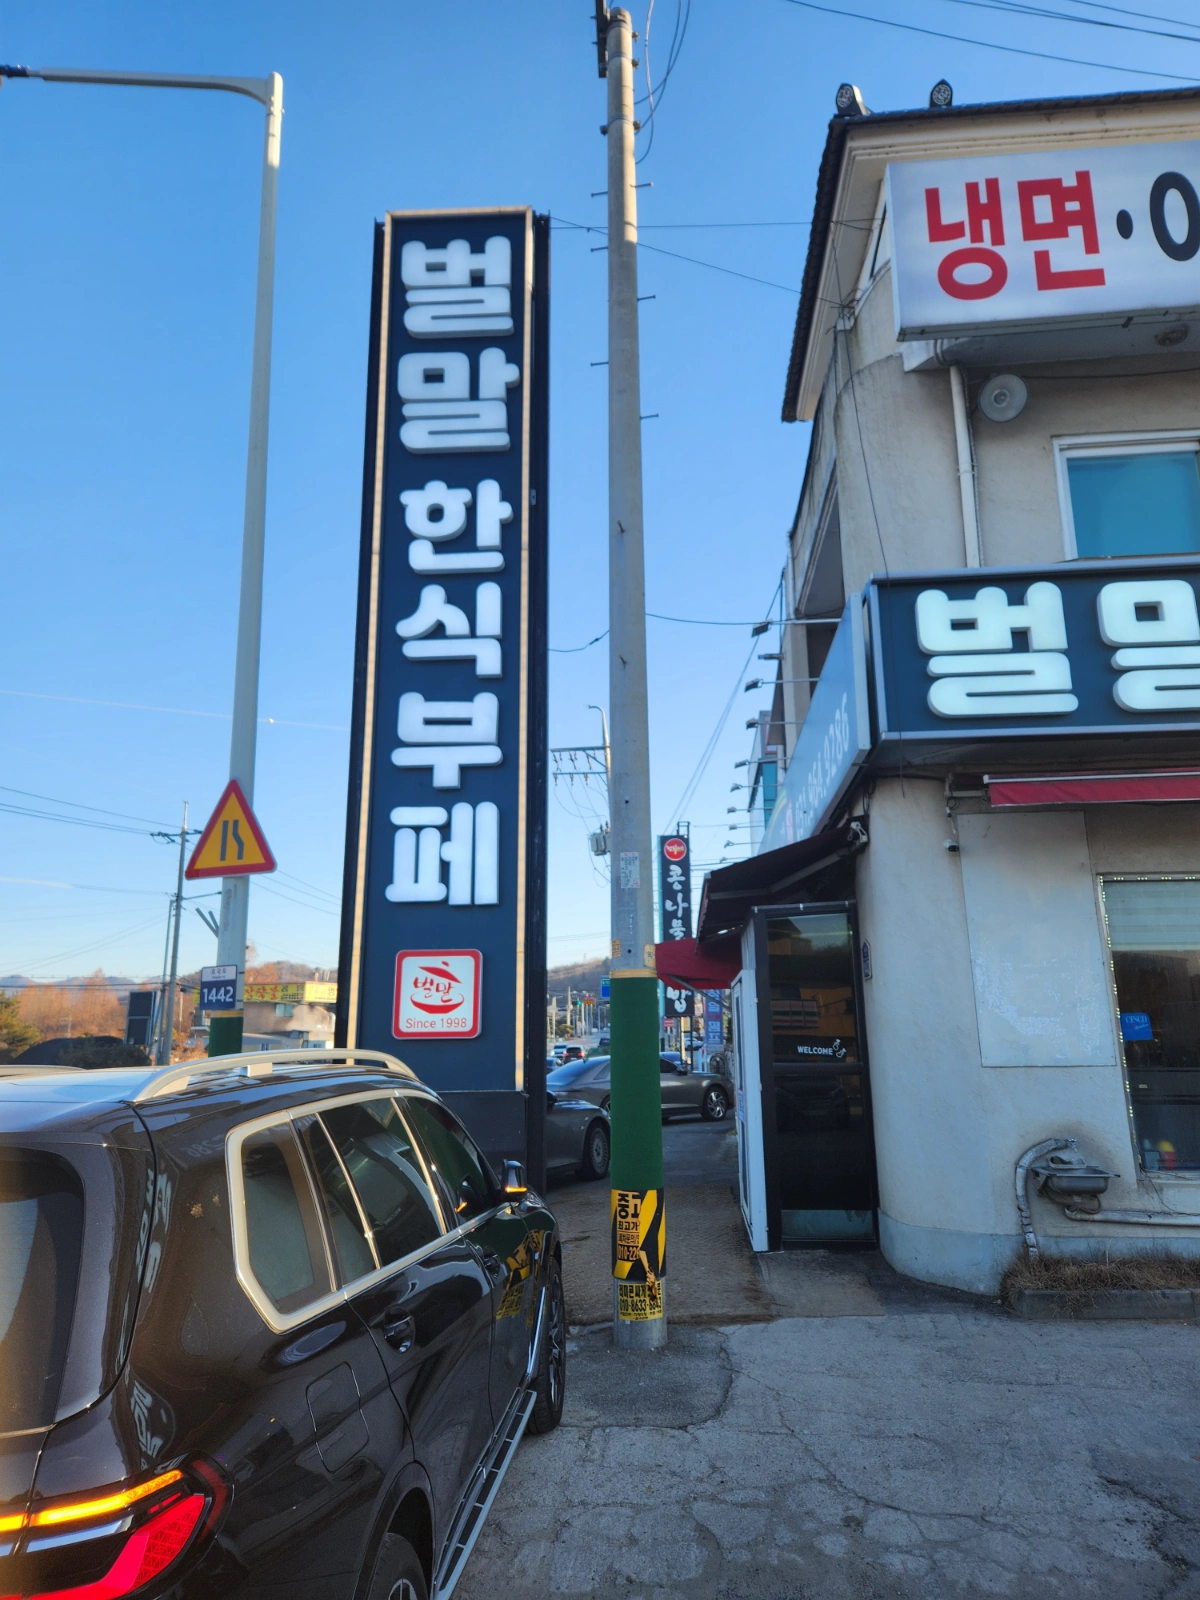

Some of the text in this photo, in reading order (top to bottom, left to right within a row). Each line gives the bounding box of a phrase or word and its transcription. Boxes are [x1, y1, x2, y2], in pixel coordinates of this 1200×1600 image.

[385, 235, 520, 905] 벌말 한식부페
[203, 986, 234, 1004] 1442
[413, 977, 455, 1003] 벌말
[406, 1018, 467, 1029] Since 1998
[797, 1046, 834, 1056] WELCOME
